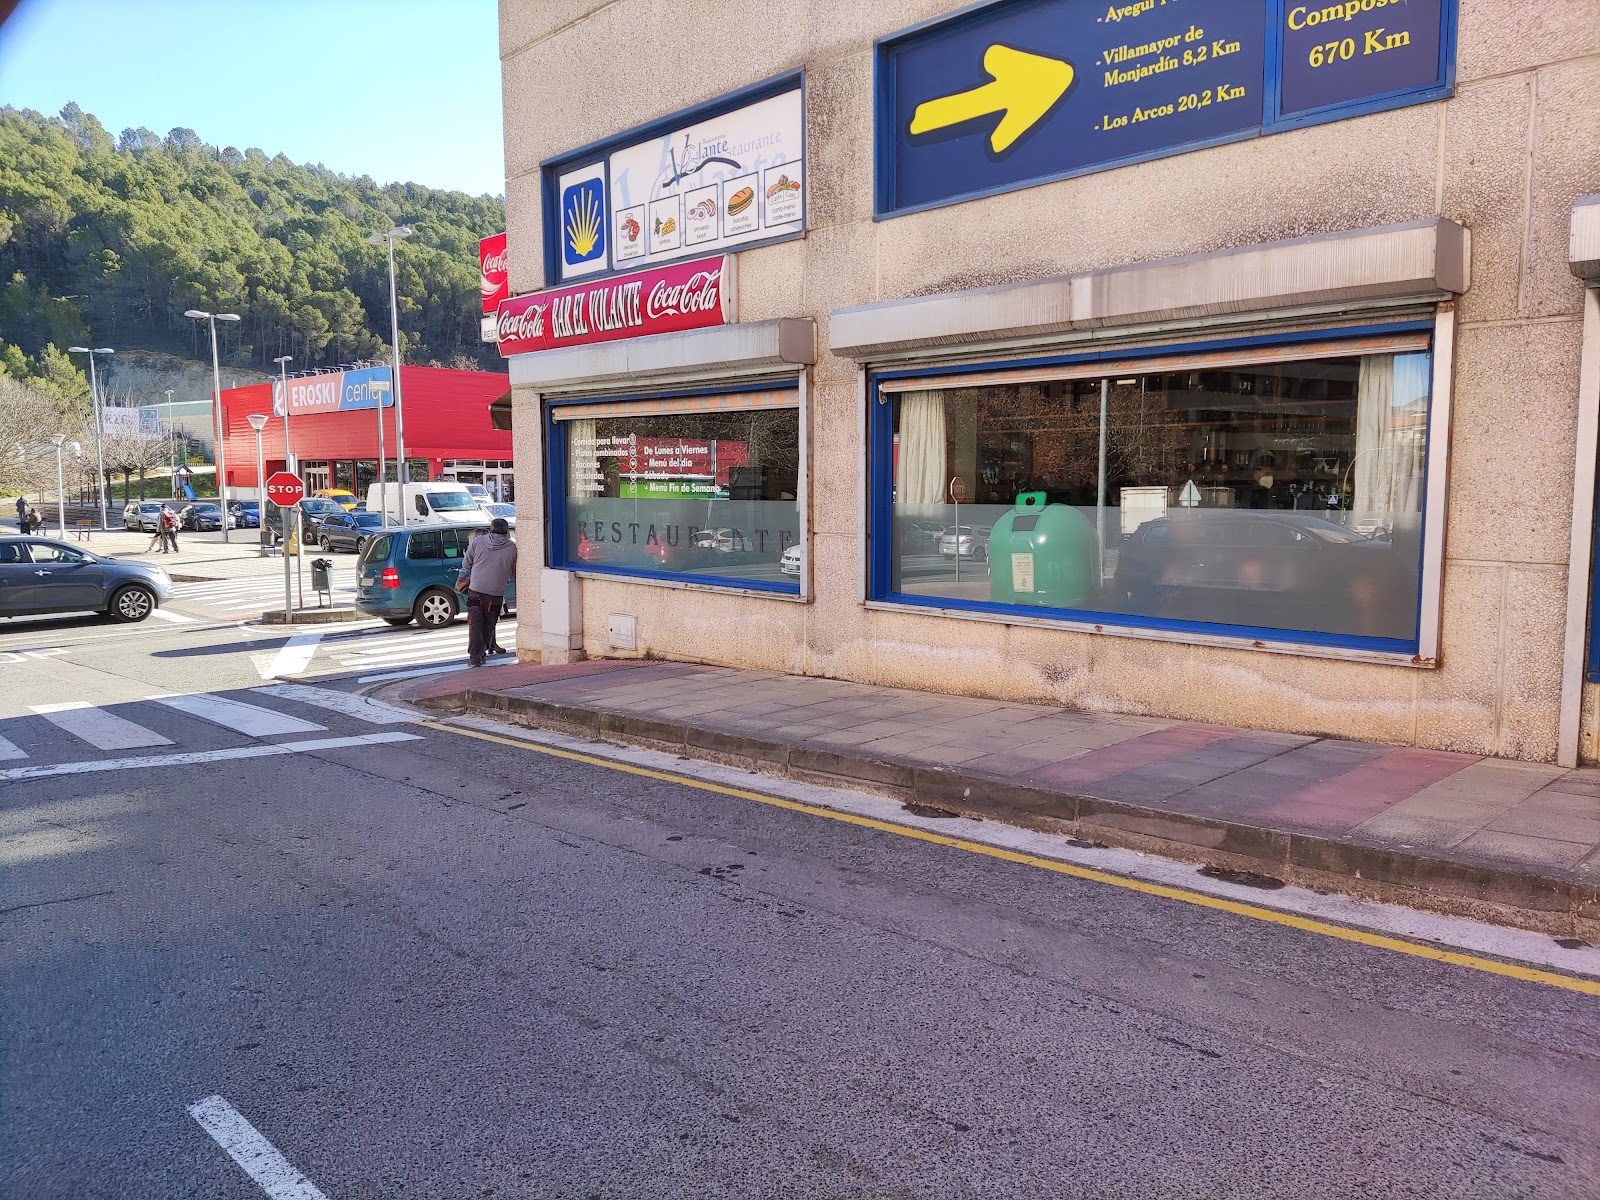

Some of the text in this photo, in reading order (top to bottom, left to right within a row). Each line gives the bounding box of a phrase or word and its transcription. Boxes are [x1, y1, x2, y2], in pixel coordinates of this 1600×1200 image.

[1103, 25, 1204, 66] Villamayor de
[1309, 28, 1411, 68] 670 Km
[1104, 39, 1241, 88] Monjardín 8,2 Km
[1103, 84, 1246, 131] Los Arcos 20,2 Km
[646, 269, 721, 319] Coca-Cola
[497, 303, 549, 343] Coca-Cola
[551, 280, 643, 339] BAR EL VOLANTE
[291, 381, 336, 408] EROSKI
[593, 447, 629, 457] combinados
[596, 438, 611, 447] para
[611, 436, 630, 445] llevar
[643, 445, 708, 455] De Lunes a Viernes
[575, 471, 605, 480] Ensaladas
[648, 457, 693, 467] Menú del día
[268, 485, 303, 494] STOP
[575, 482, 605, 491] Bocadillos
[649, 482, 668, 492] Menú
[668, 483, 680, 492] Fin
[681, 483, 690, 492] de
[578, 520, 793, 554] RESTAURANTE
